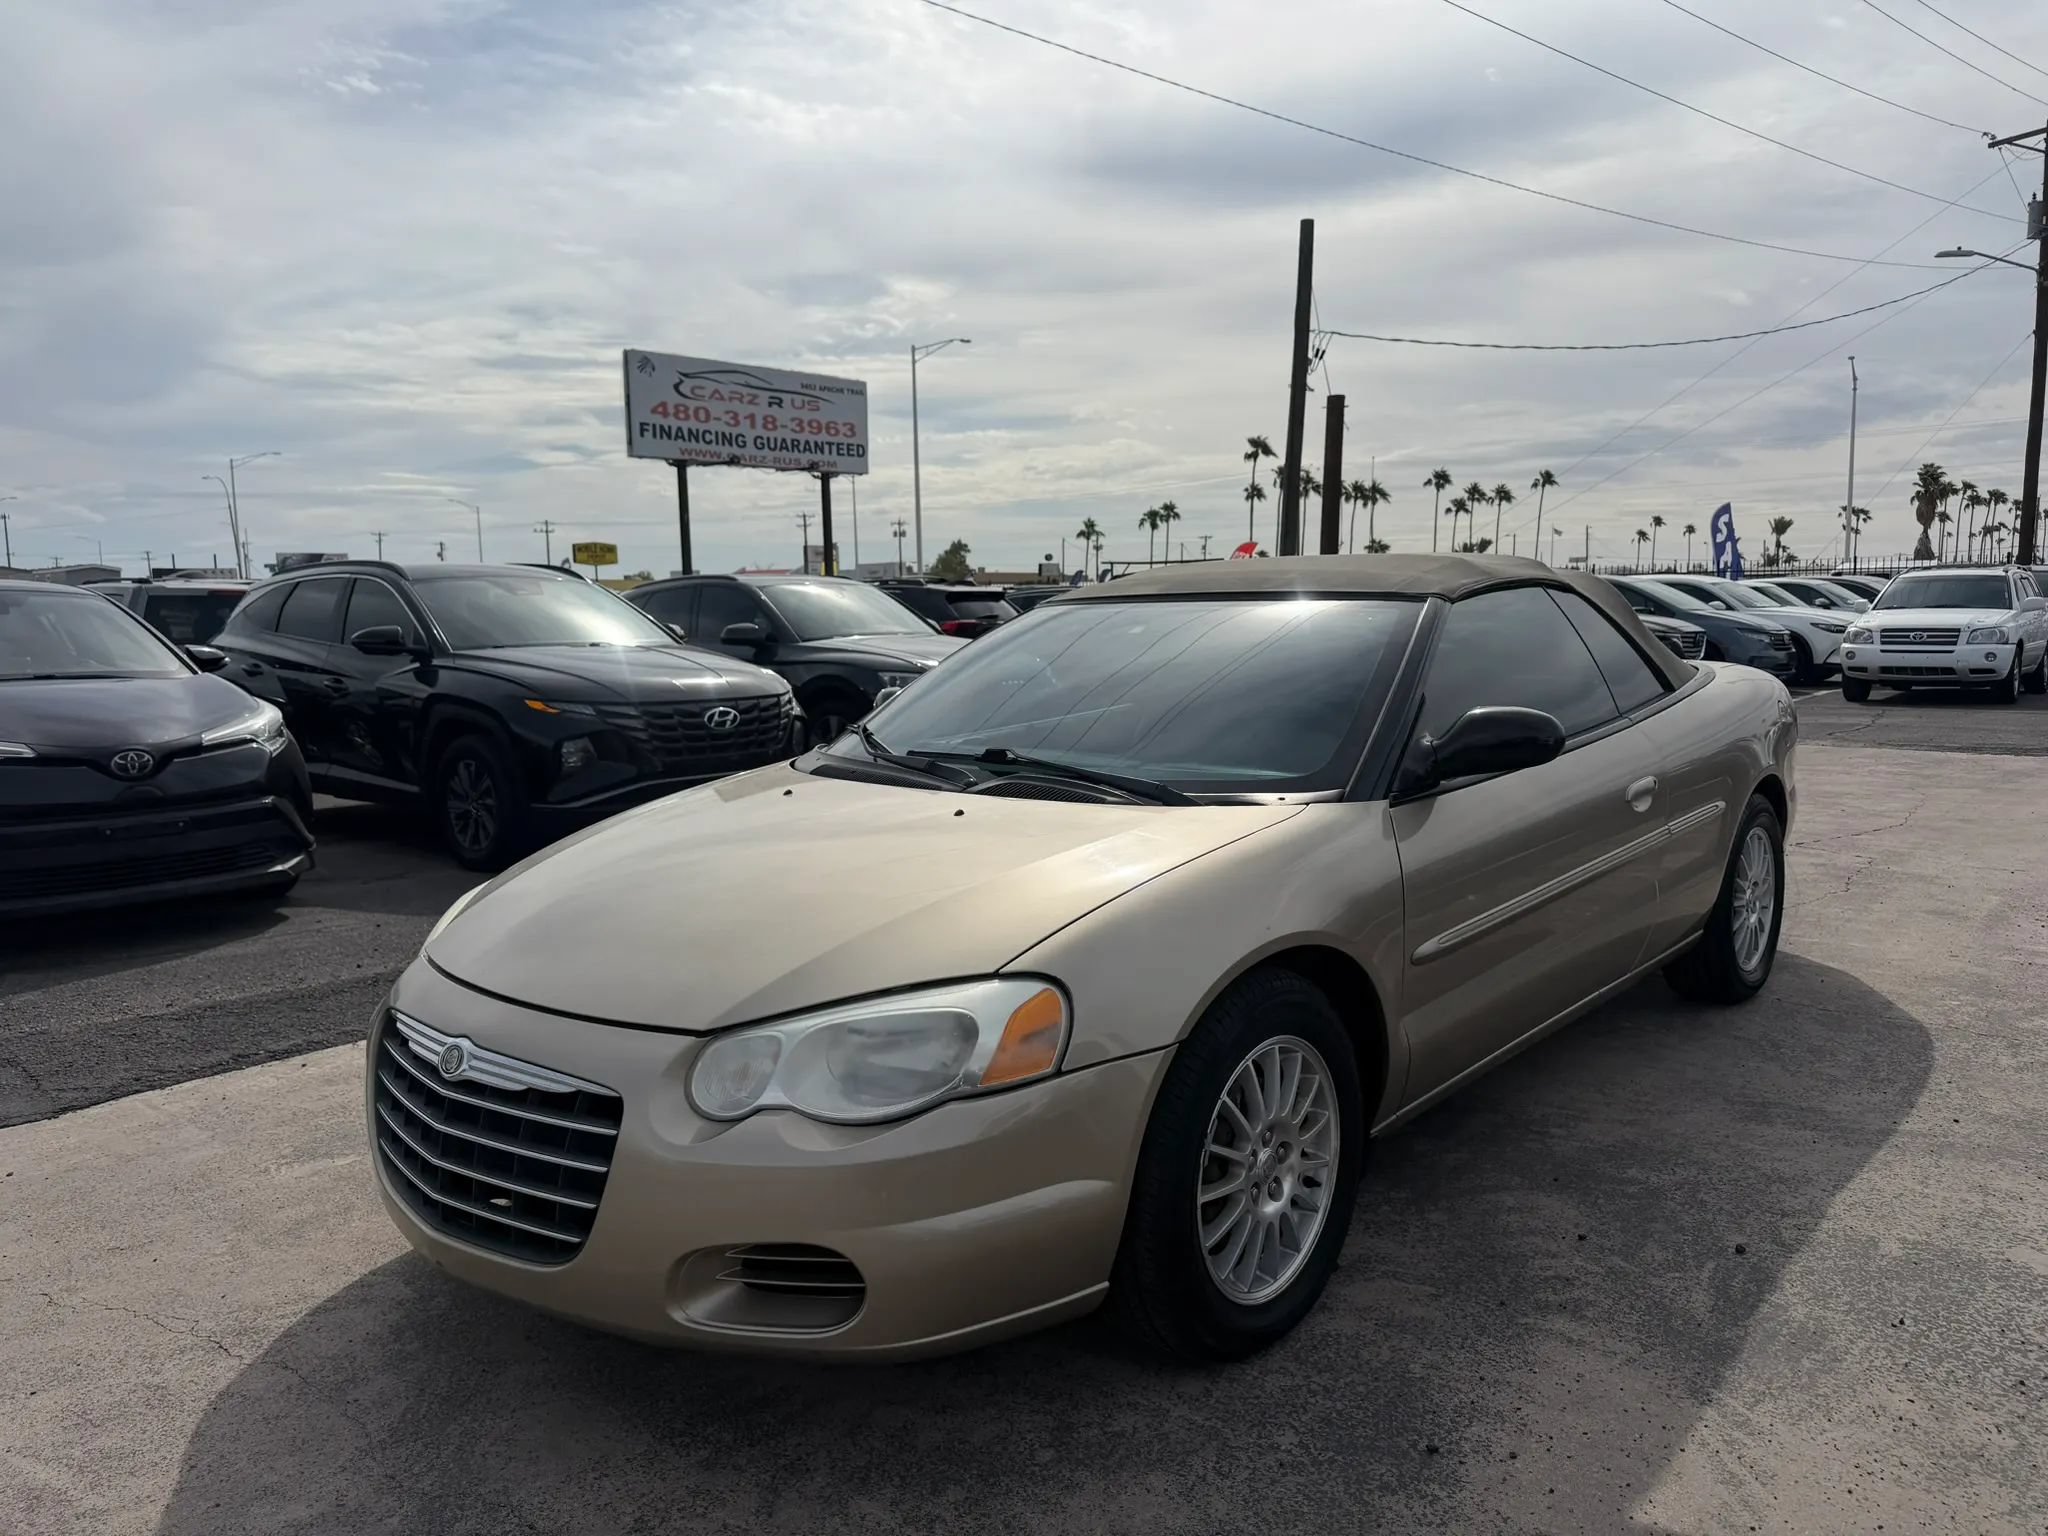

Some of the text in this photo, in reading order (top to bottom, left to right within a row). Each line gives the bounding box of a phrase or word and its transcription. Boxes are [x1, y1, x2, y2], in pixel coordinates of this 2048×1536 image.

[689, 385, 821, 412] CARZ R US
[846, 388, 865, 397] TRAIL
[650, 401, 857, 438] 480-318-3963
[639, 422, 866, 458] FINANCING GUARANTEED
